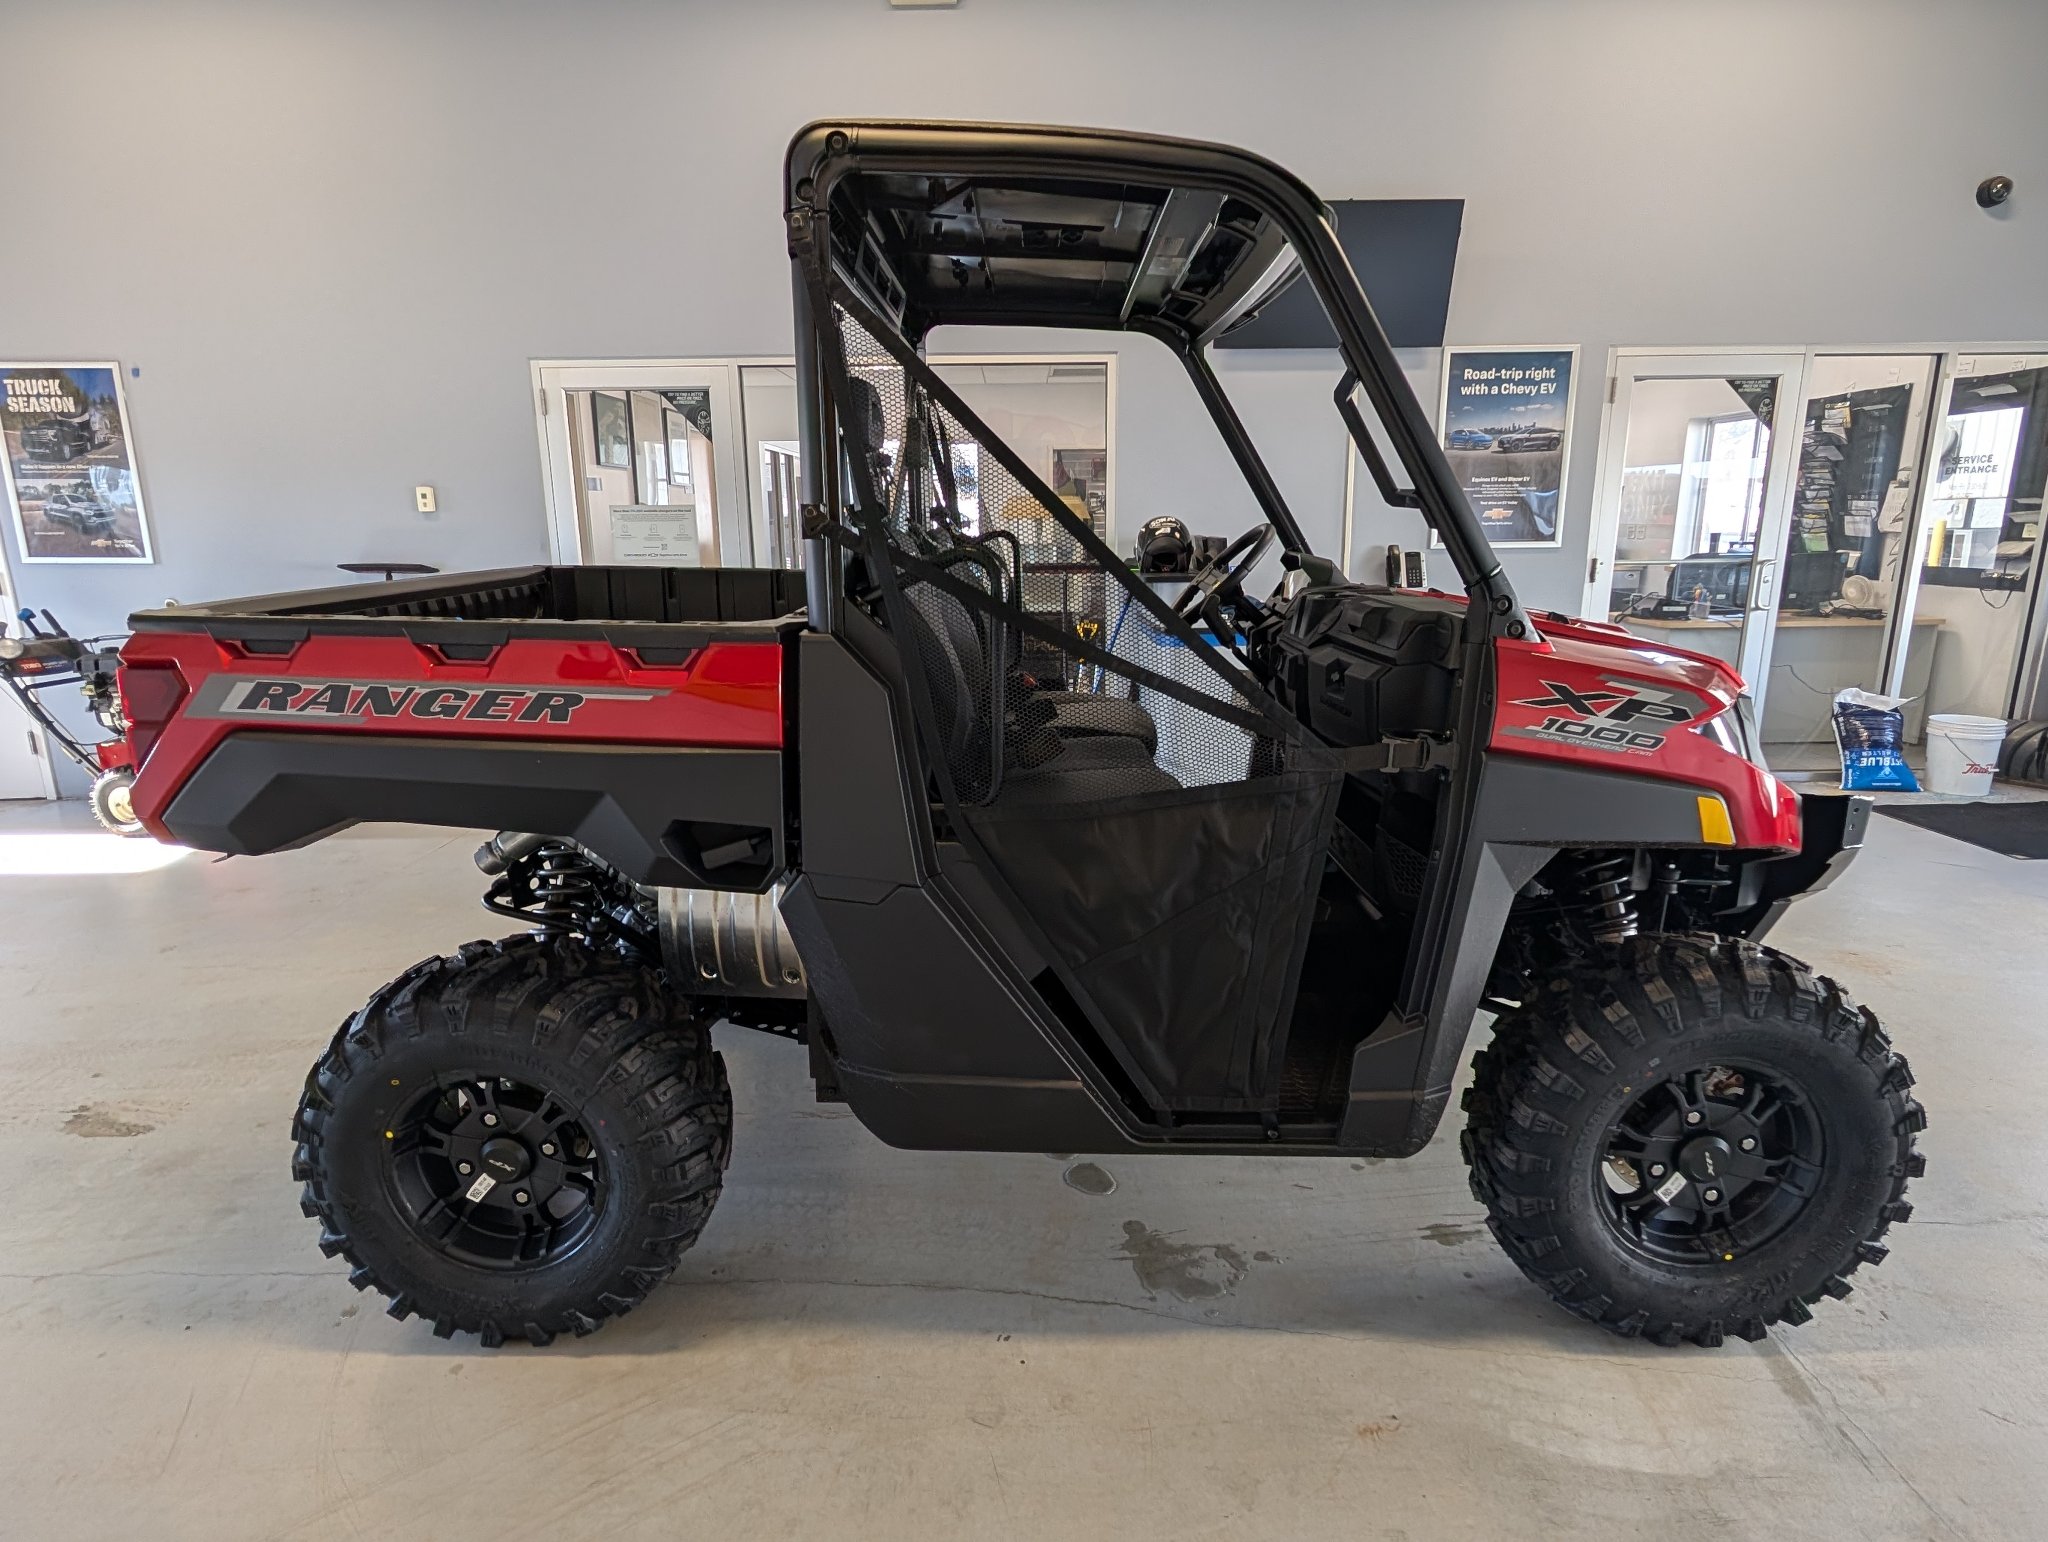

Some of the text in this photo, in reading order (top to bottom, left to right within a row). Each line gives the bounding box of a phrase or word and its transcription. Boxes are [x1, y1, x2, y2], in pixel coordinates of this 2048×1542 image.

[1464, 367, 1556, 381] Road-trip right
[3, 378, 63, 396] TRUCK
[1461, 382, 1557, 397] with a Chevy EV
[6, 396, 76, 413] SEASON
[1951, 454, 1994, 466] SERVICE
[1944, 465, 1999, 475] ENTRANCE
[237, 679, 586, 724] RANGER
[1507, 679, 1695, 723] XP
[1539, 715, 1666, 751] 1000
[1535, 732, 1565, 742] DUAL
[1566, 737, 1628, 752] OVERHEAD
